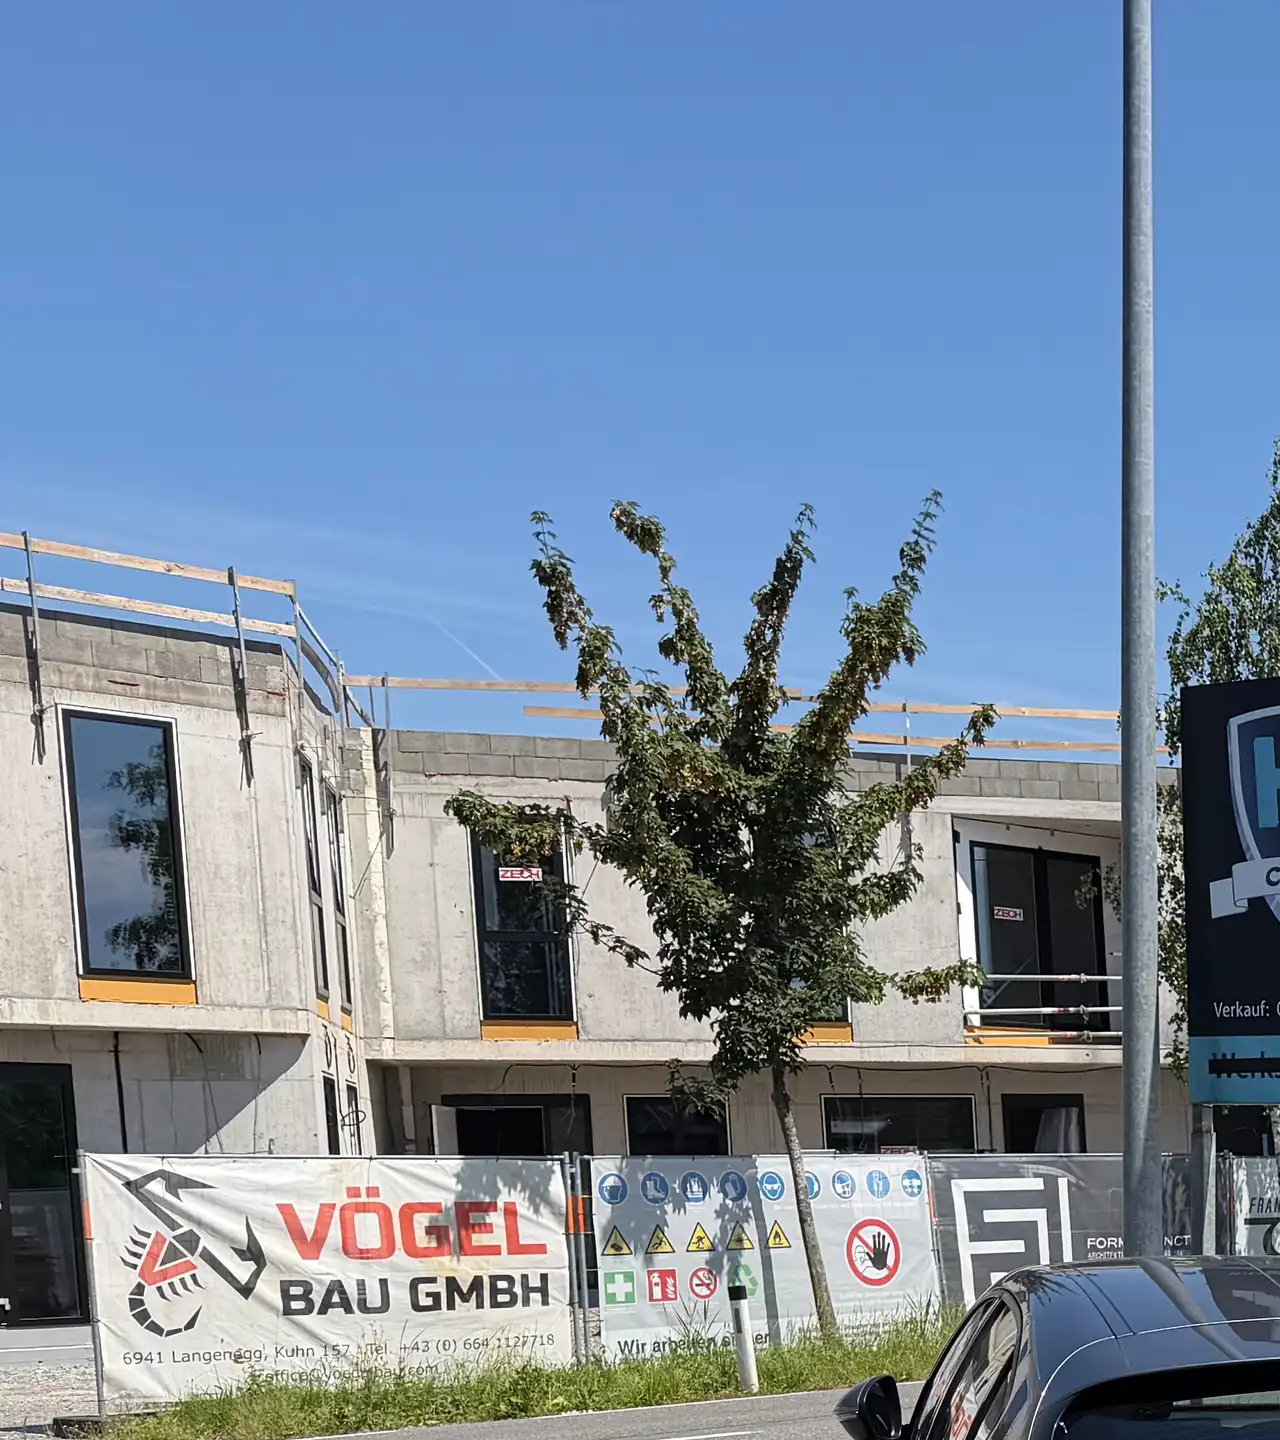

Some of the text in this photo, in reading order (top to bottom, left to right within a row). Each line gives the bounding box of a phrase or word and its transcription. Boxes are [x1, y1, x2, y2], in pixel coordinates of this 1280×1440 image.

[500, 870, 540, 880] ZECH
[1213, 1001, 1270, 1018] Verkauf:
[275, 1186, 548, 1261] VÖGEL
[279, 1272, 550, 1316] BAU GMBH
[123, 1350, 163, 1364] 6941
[172, 1349, 268, 1365] Langenegg,
[275, 1345, 315, 1359] Kuhn
[321, 1344, 350, 1357] 157
[400, 1340, 430, 1353] +43
[436, 1338, 457, 1354] (0)
[463, 1338, 489, 1350] 664
[617, 1338, 647, 1355] Wir
